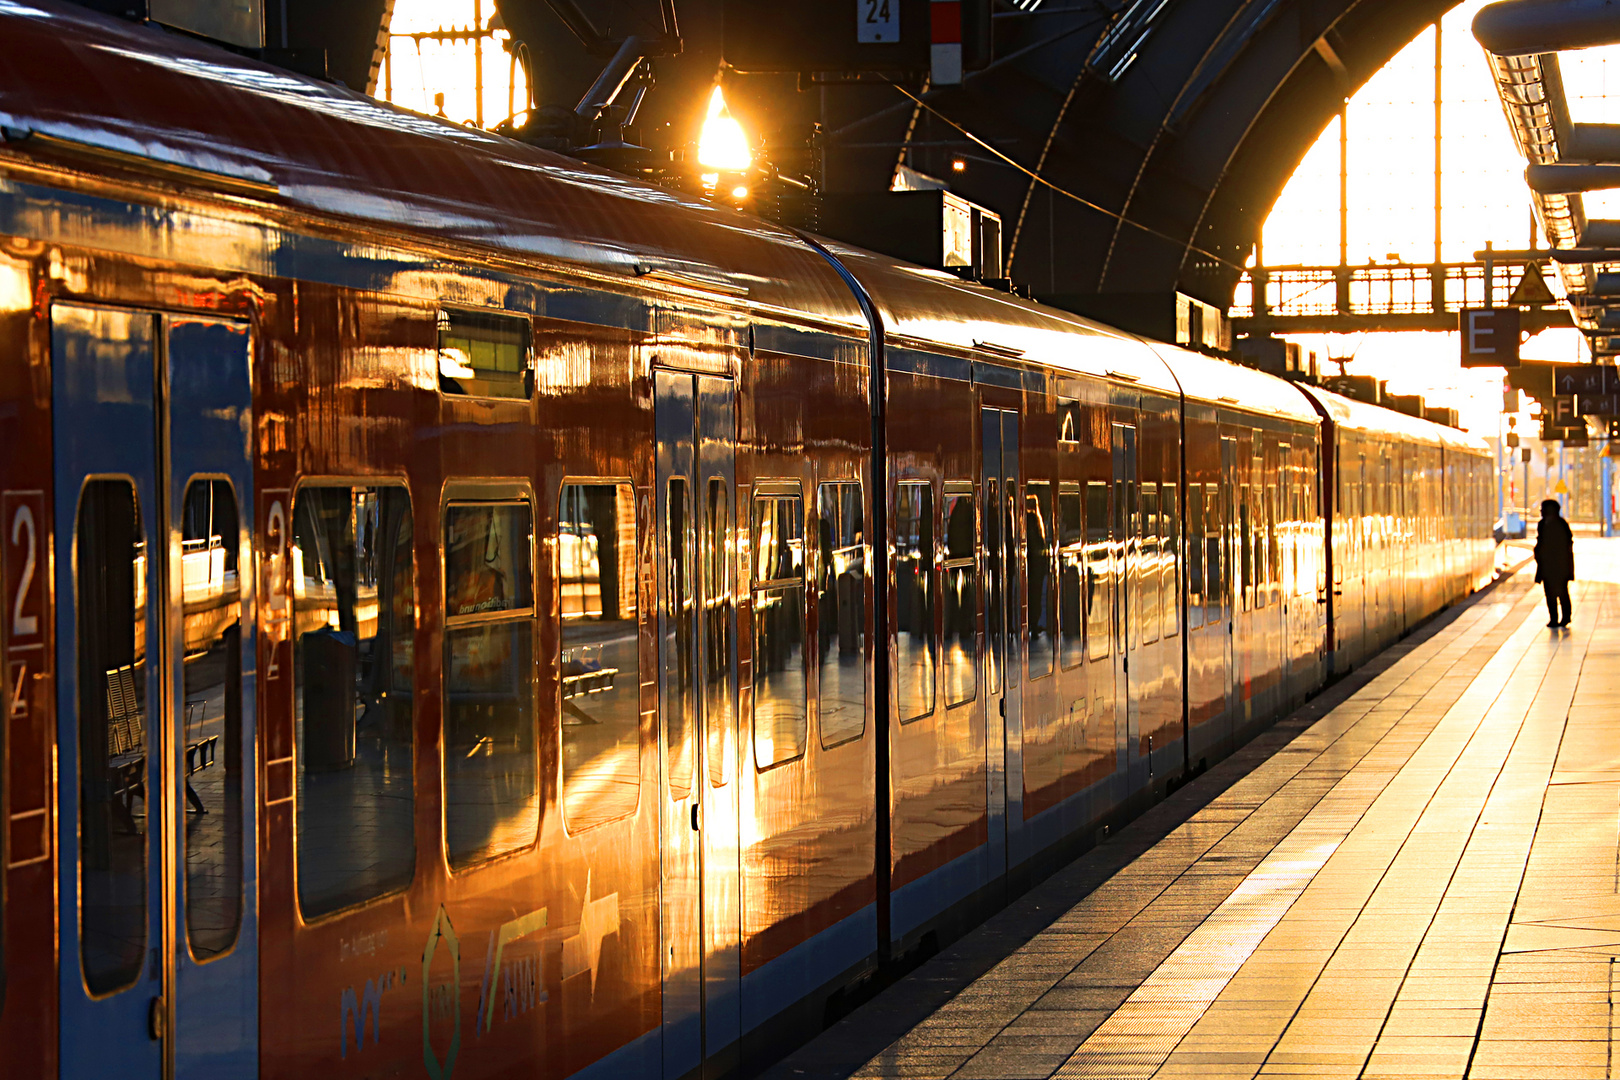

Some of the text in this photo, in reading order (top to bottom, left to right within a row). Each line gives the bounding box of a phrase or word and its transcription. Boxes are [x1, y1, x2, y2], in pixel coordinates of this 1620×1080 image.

[866, 0, 890, 23] 24
[1469, 312, 1495, 354] E
[1557, 400, 1570, 421] F
[12, 505, 37, 634] 2
[267, 500, 285, 610] 2
